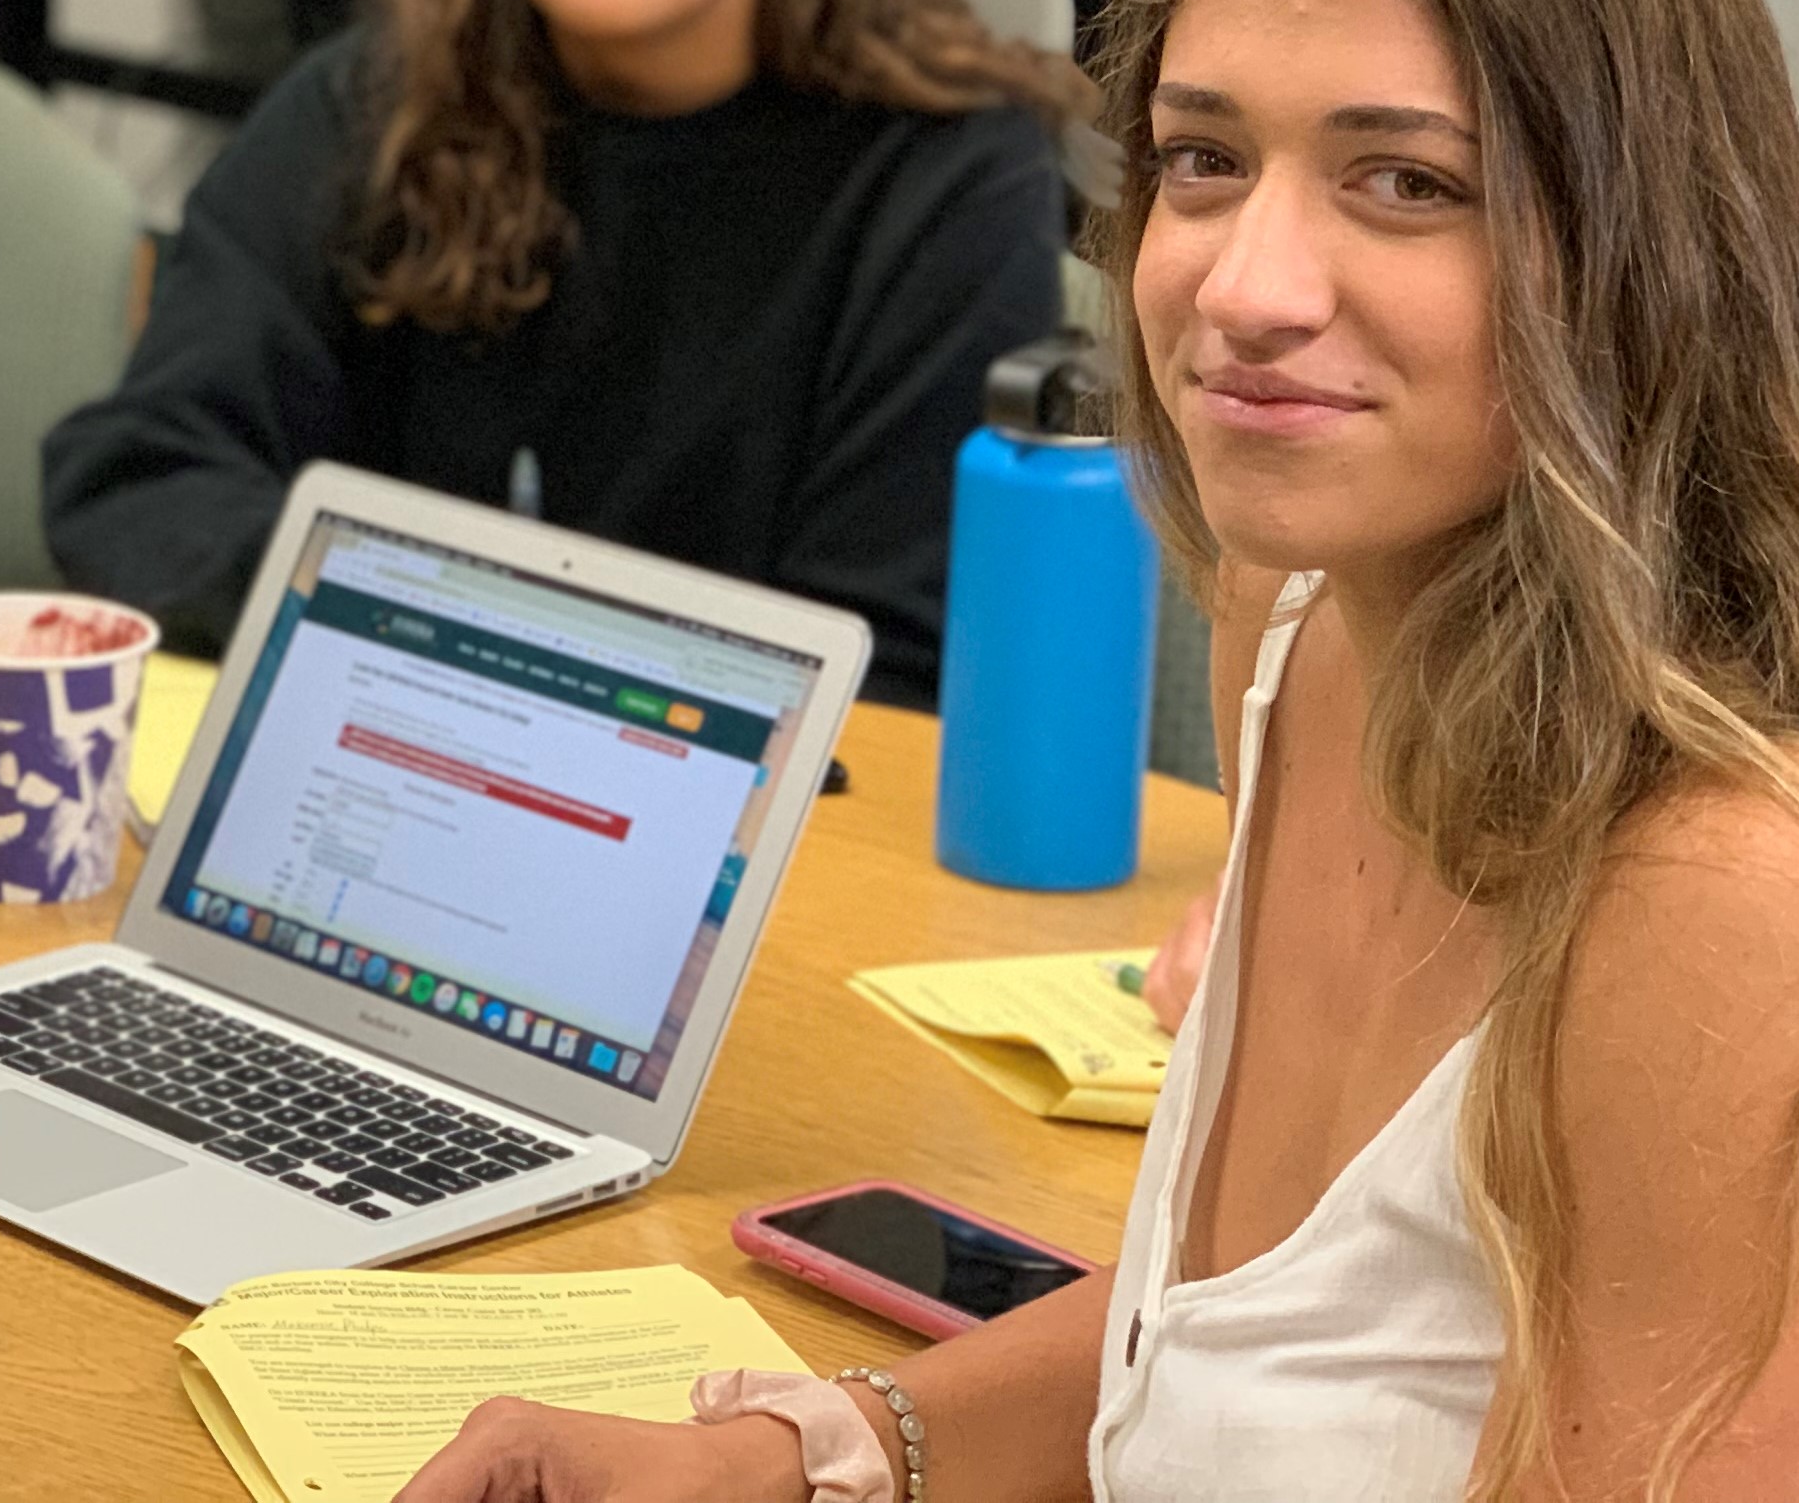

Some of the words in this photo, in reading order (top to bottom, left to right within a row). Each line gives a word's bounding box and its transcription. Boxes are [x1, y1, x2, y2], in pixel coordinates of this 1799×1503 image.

[323, 1279, 347, 1287] City
[350, 1280, 397, 1289] College
[237, 1287, 344, 1301] Major/Career
[348, 1287, 439, 1298] Exploration
[442, 1292, 537, 1300] Instructions
[567, 1288, 633, 1298] Athletes
[220, 1322, 266, 1330] NAME:
